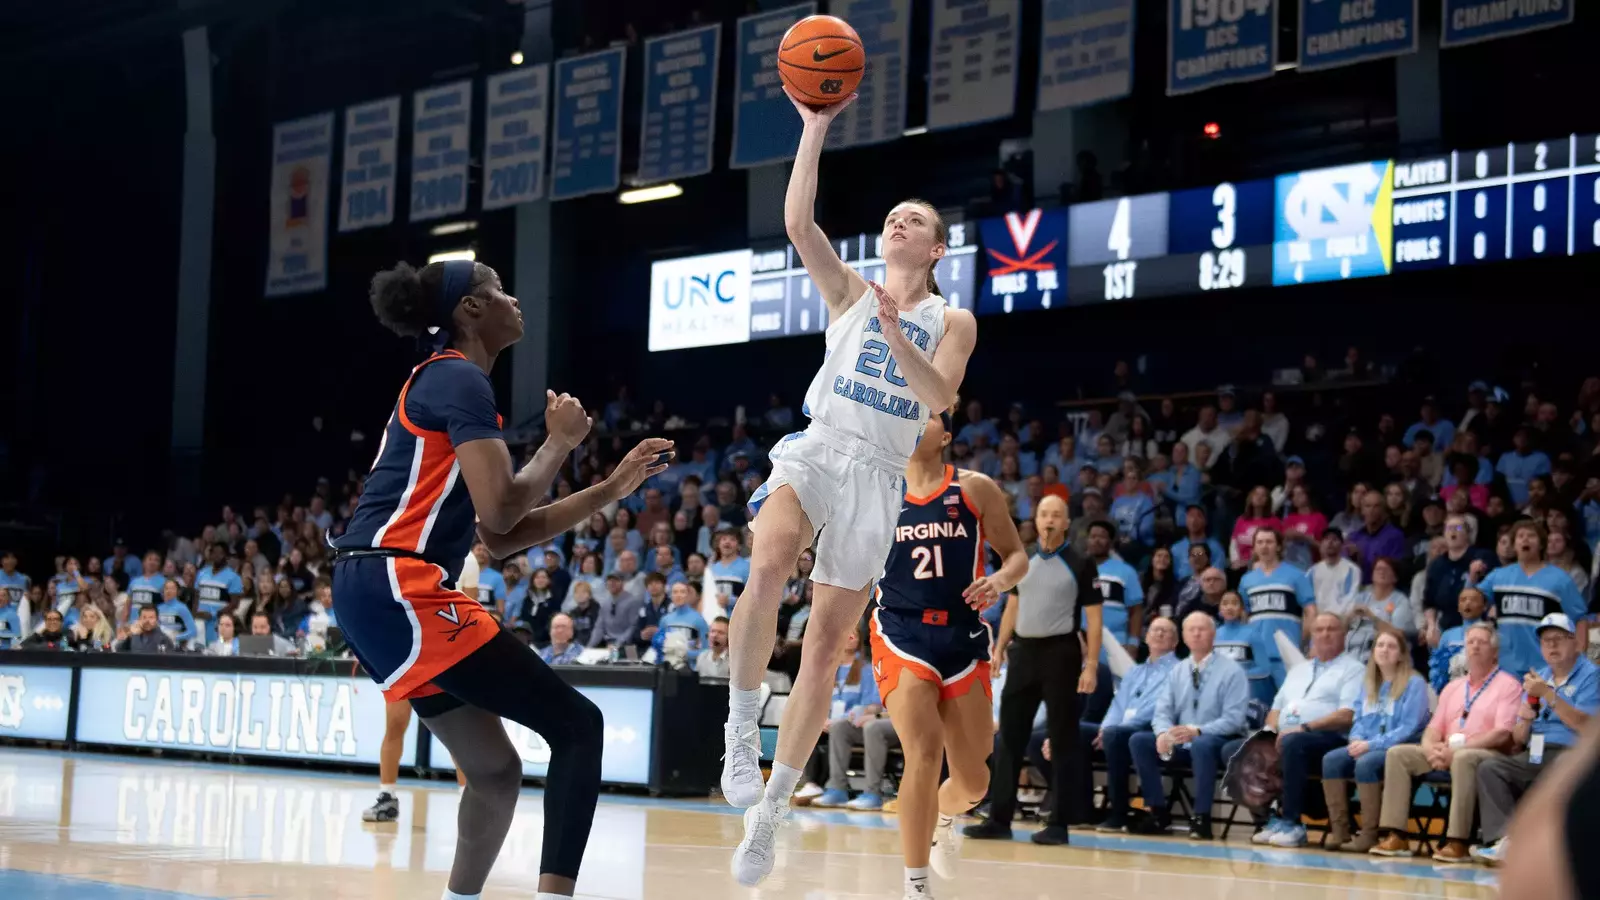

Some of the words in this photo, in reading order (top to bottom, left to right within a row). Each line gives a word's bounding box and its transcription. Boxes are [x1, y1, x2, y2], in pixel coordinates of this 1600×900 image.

[1339, 1, 1375, 23] ACC
[1453, 0, 1563, 31] CHAMPIONS
[1206, 25, 1238, 49] ACC
[1306, 18, 1406, 55] CHAMPIONS
[1176, 45, 1267, 79] CHAMPIONS
[1394, 160, 1447, 187] PLAYER
[1475, 150, 1488, 179] 0
[1535, 142, 1548, 171] 2
[1211, 182, 1236, 248] 3
[1393, 198, 1446, 226] POINTS
[1474, 191, 1487, 219] 0
[1533, 184, 1546, 212] 0
[1107, 197, 1131, 260] 4
[1395, 236, 1442, 263] FOULS
[1473, 231, 1486, 260] 0
[1532, 225, 1546, 253] 0
[664, 269, 736, 310] UNC
[1102, 261, 1137, 300] 1ST
[833, 375, 920, 420] CAROLINA
[895, 522, 968, 543] IRGINIA
[911, 544, 944, 580] 21
[123, 675, 358, 757] CAROLINA
